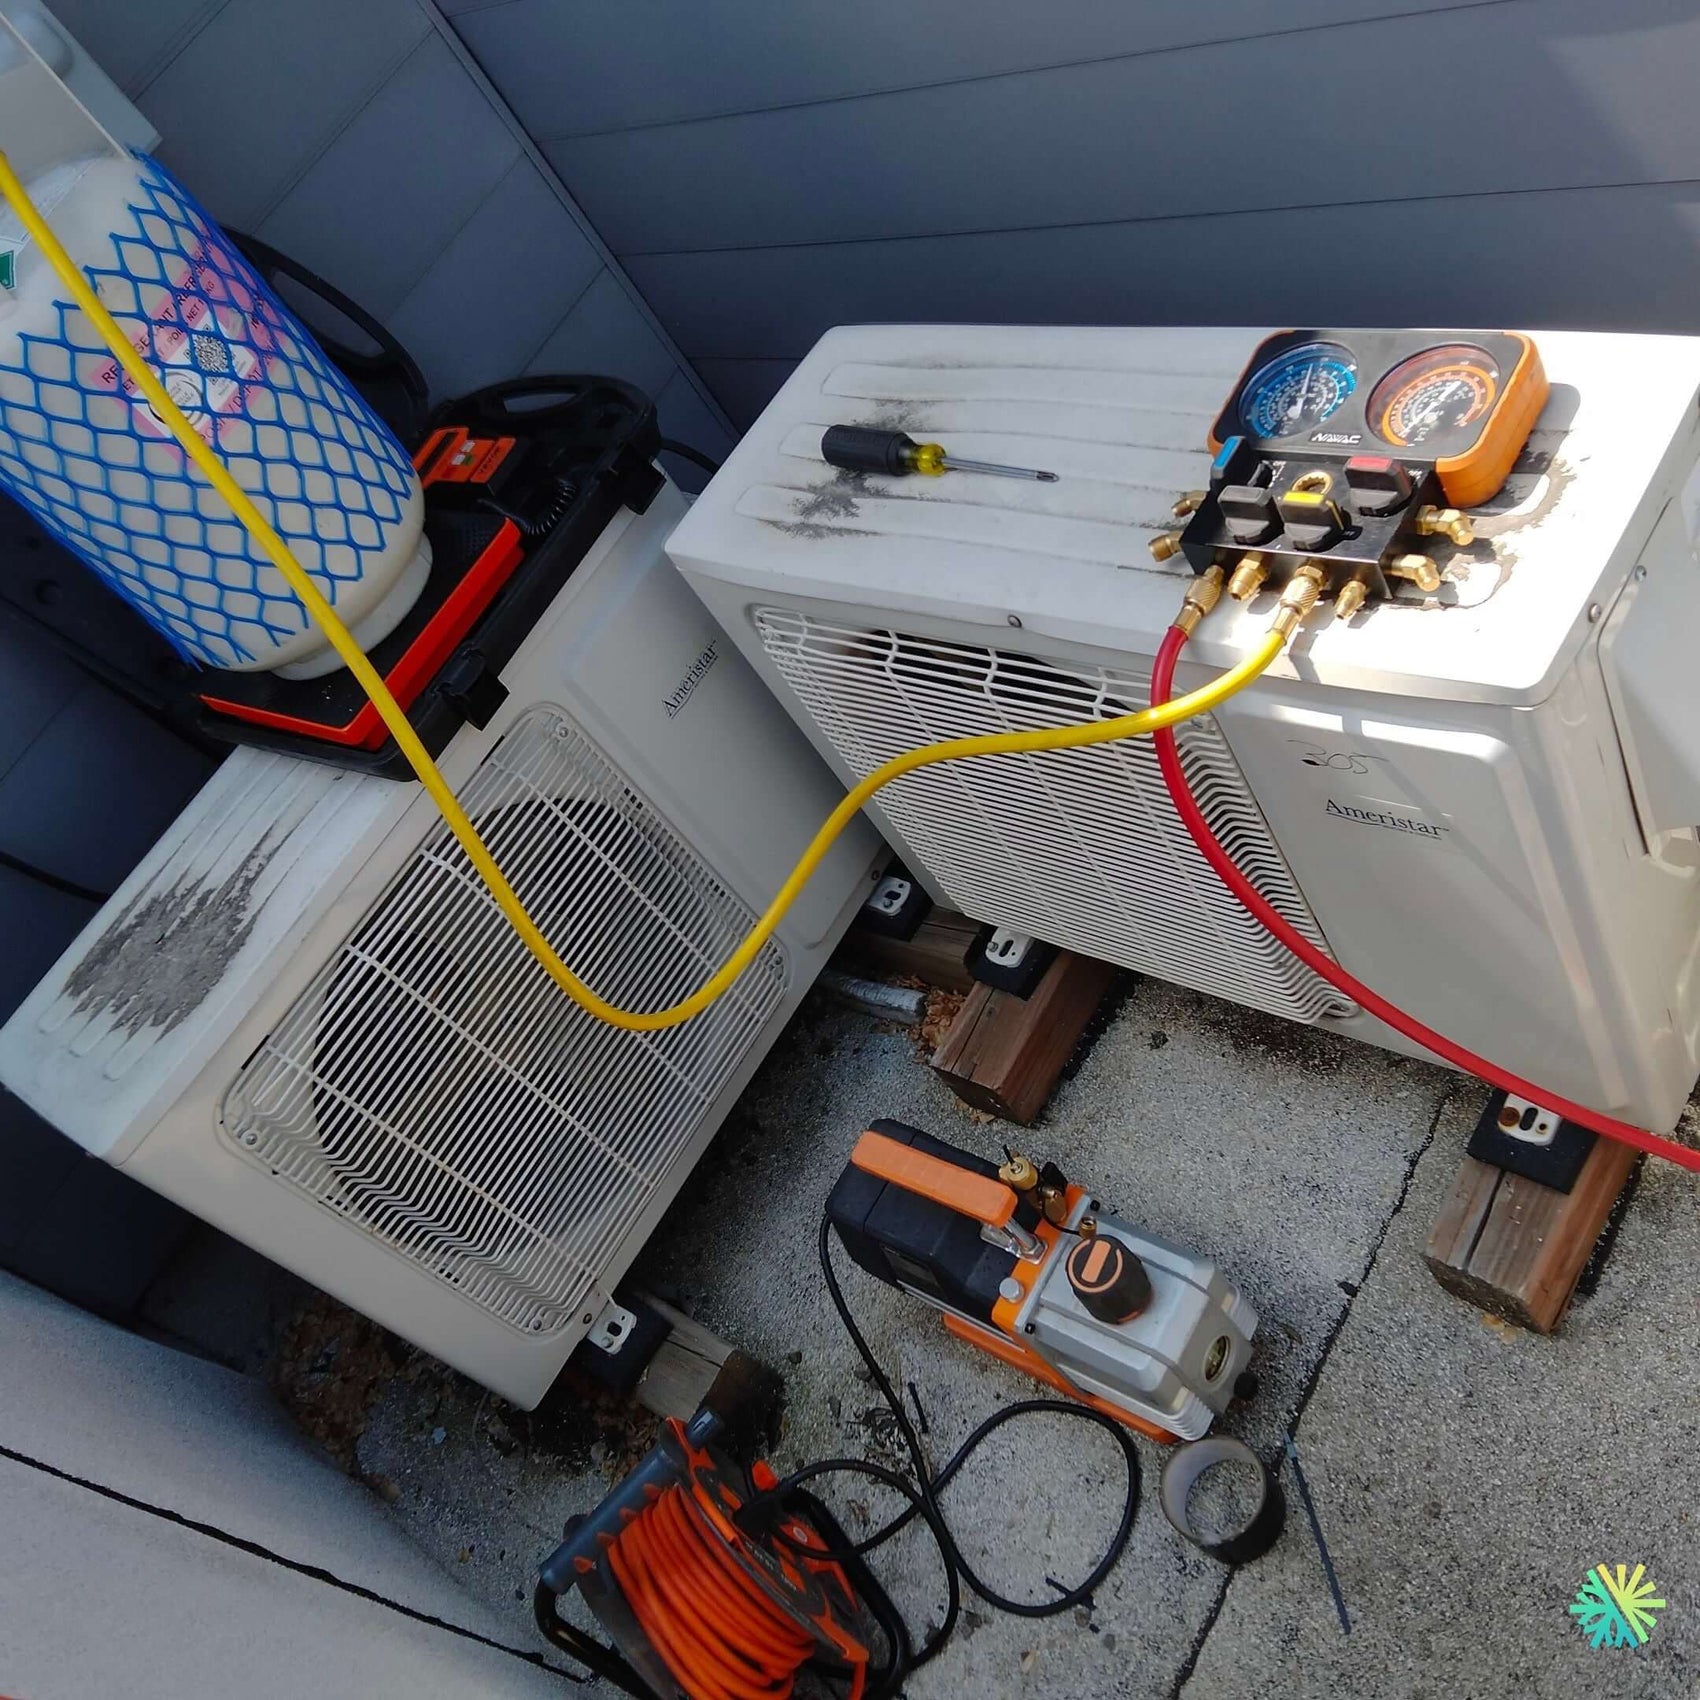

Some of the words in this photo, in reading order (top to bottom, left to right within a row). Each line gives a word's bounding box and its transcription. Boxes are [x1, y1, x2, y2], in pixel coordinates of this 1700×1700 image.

[184, 303, 200, 322] NET
[662, 643, 716, 716] Ameristar
[1325, 799, 1442, 836] Ameristar
